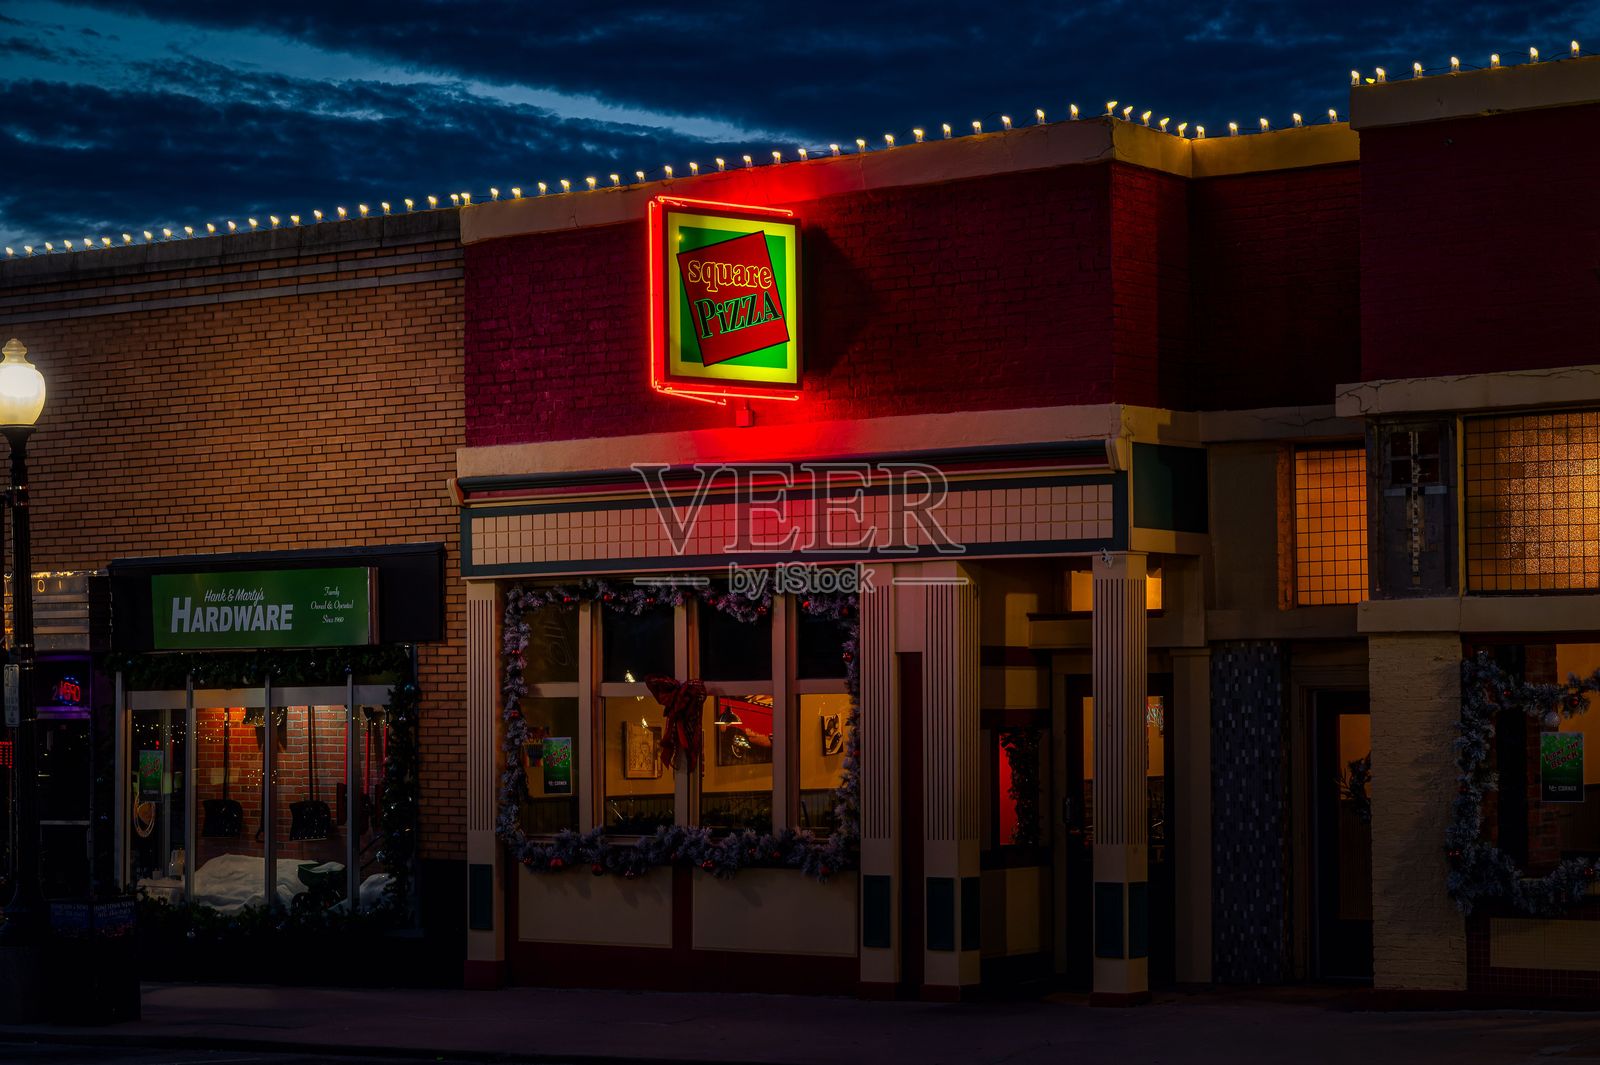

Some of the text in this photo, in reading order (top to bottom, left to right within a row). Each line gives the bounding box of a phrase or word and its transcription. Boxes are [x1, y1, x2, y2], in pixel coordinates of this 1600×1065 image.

[688, 259, 772, 293] square
[204, 587, 265, 607] Hank & Marty's
[310, 599, 354, 611] Owned & Operated
[170, 596, 294, 633] HARDWARE
